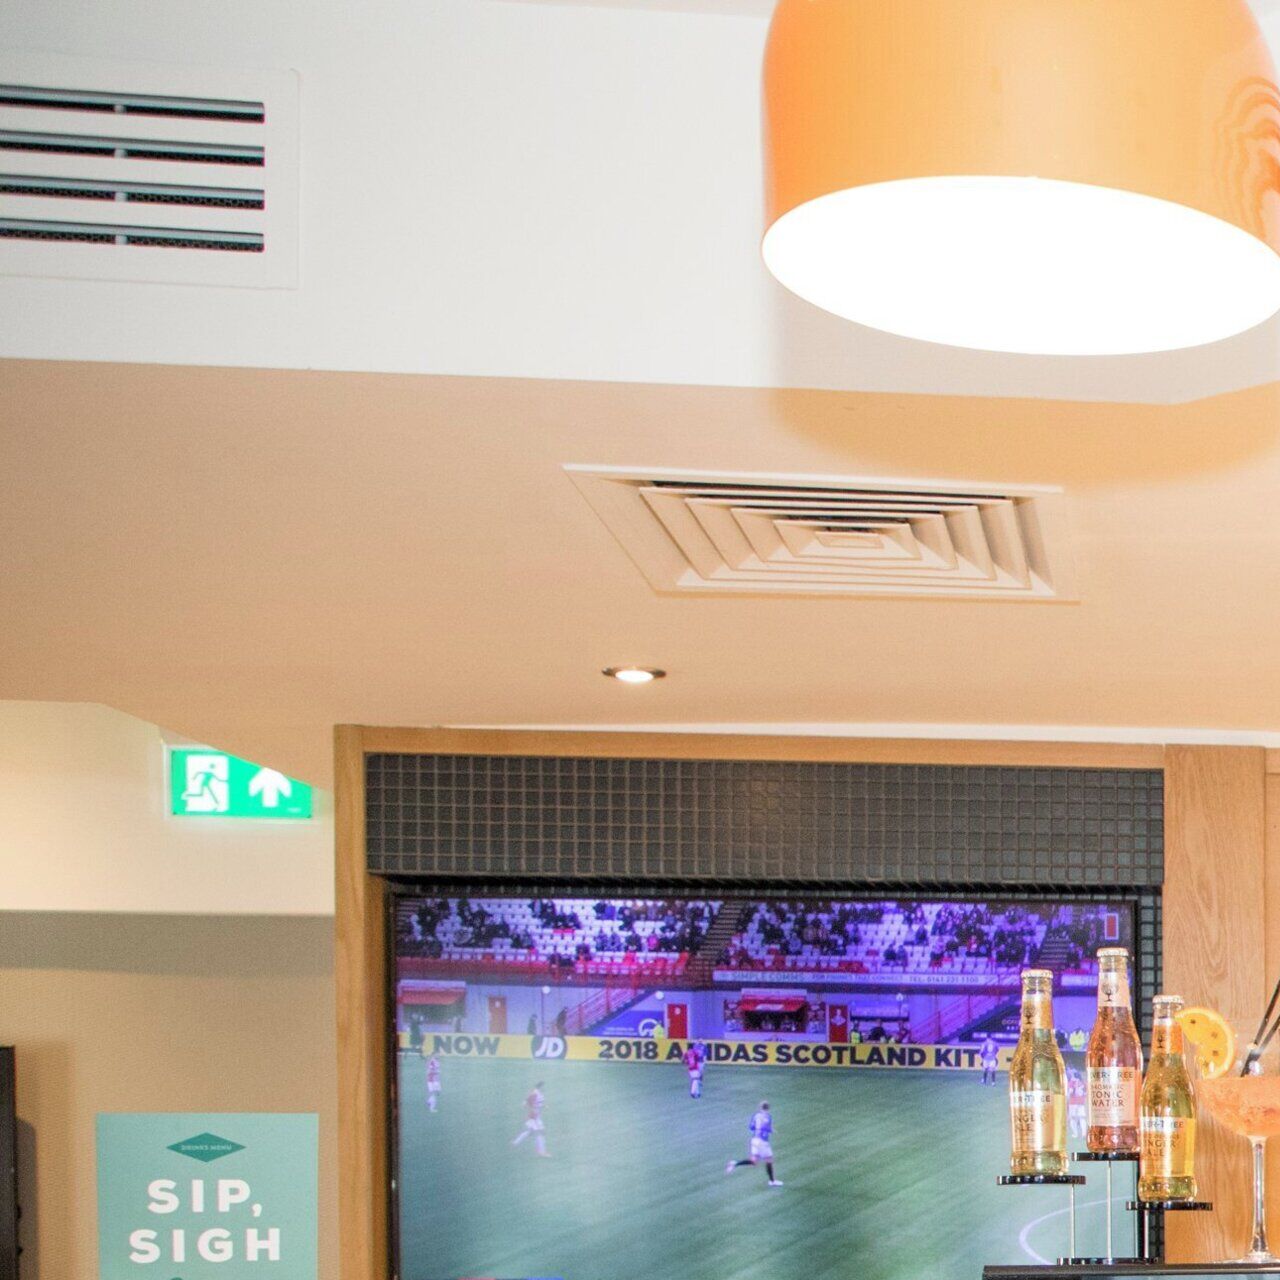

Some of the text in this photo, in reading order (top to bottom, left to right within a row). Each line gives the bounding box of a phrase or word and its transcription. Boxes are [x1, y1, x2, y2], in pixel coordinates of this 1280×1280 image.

[433, 1034, 500, 1056] NOW
[535, 1036, 564, 1059] JD
[598, 1039, 658, 1061] 2018
[666, 1041, 768, 1063] AIDAS
[775, 1043, 927, 1067] SCOTLAND
[147, 1178, 263, 1218] SIP,
[128, 1227, 281, 1264] SIGH
